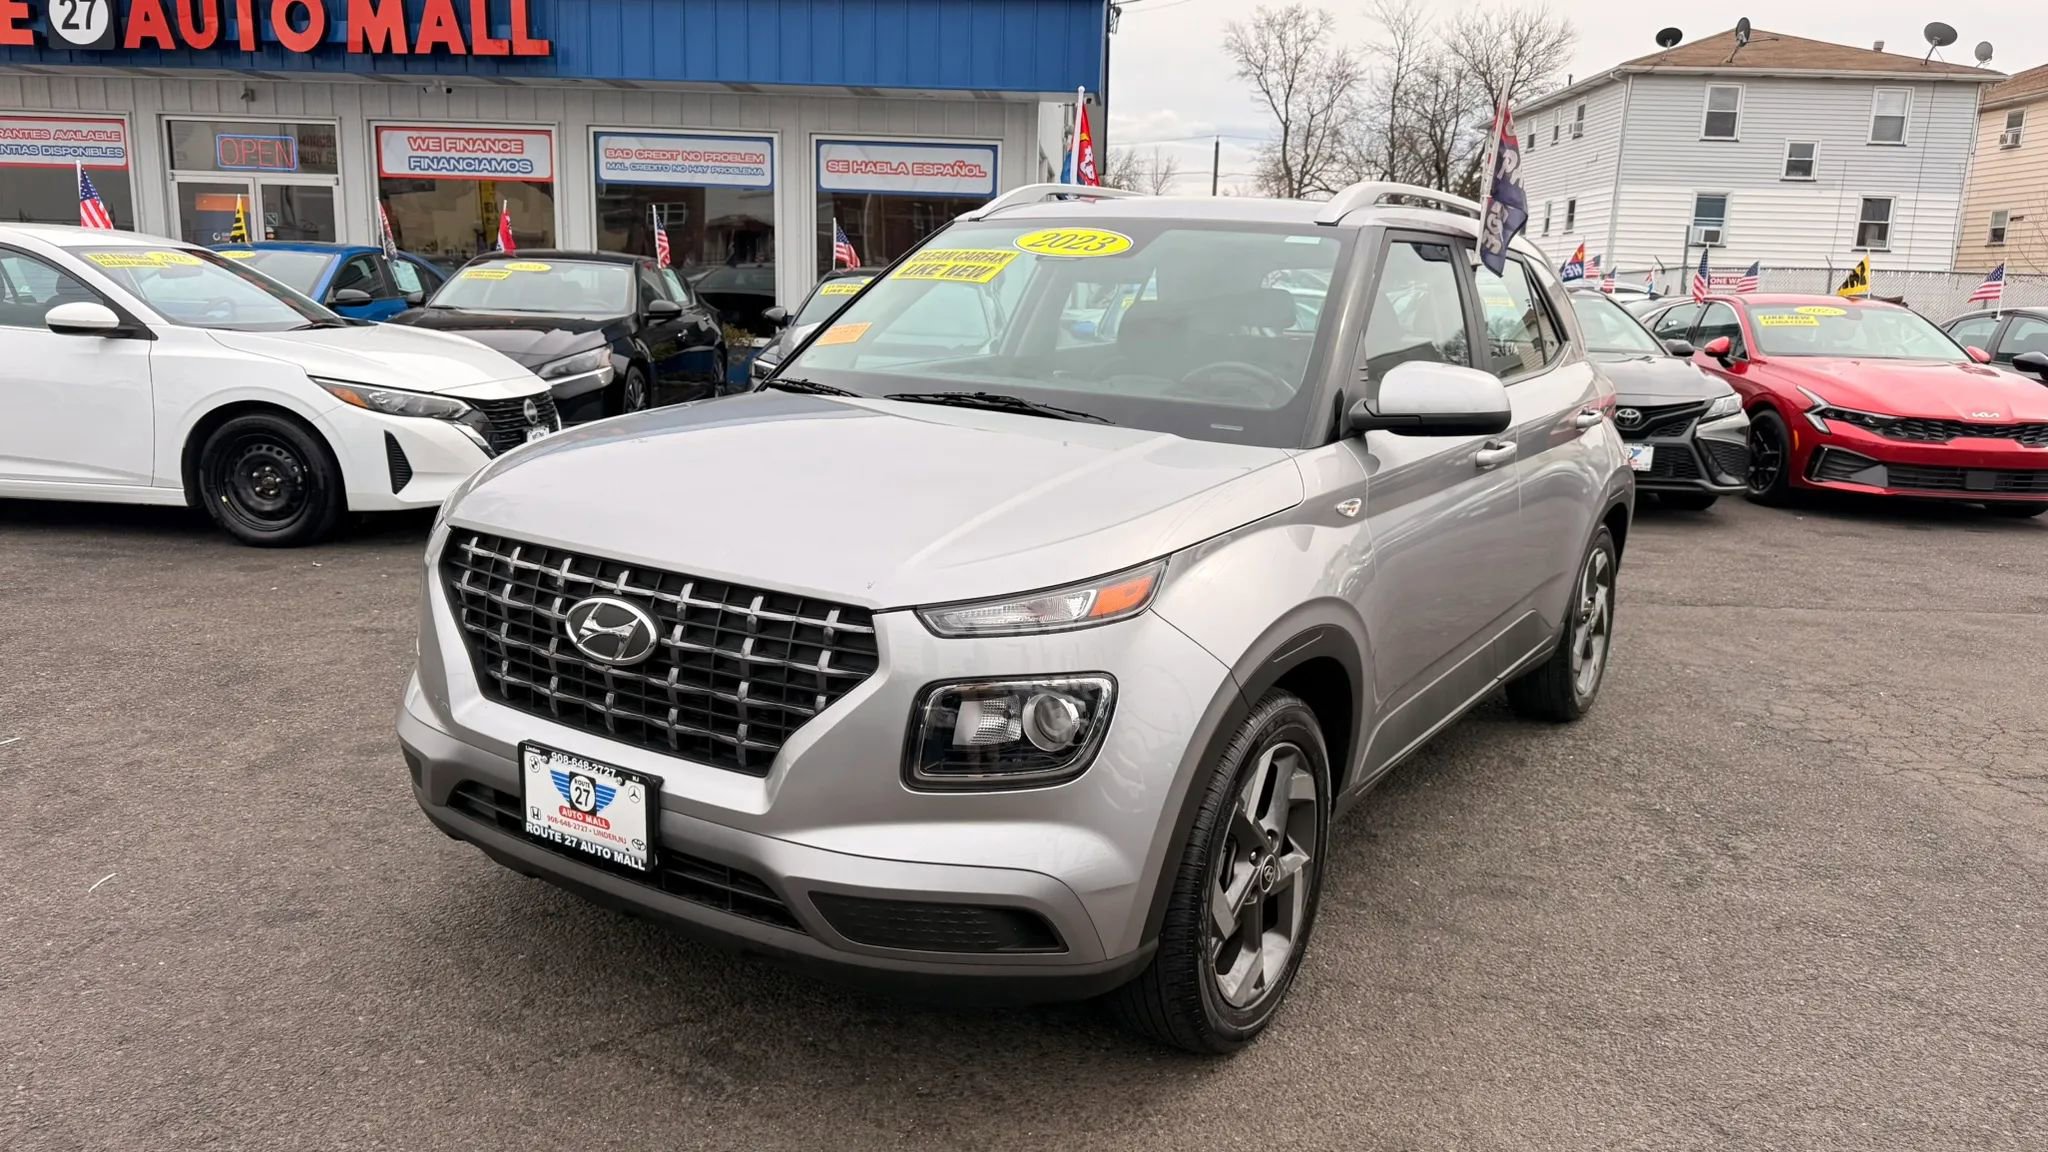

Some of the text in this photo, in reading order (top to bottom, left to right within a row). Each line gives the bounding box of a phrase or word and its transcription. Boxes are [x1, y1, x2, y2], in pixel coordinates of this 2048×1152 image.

[60, 0, 97, 30] 27
[123, 0, 325, 52] AUTO
[347, 0, 550, 56] MALL
[53, 130, 121, 142] AVAILABLE
[41, 145, 125, 158] DISPONIBLES
[221, 138, 294, 168] OPEN
[408, 136, 524, 154] WE FINANCE
[408, 156, 533, 173] FINANCIAMOS
[605, 148, 765, 164] BAD CREDIT NO PROBLEM
[606, 162, 764, 176] MAL CREDITO NO HAY PROBLEMA
[827, 160, 987, 177] SE HABLA ESPAÑOL
[1027, 232, 1118, 252] 2023
[911, 251, 1016, 264] CLEAN CARFAX
[898, 263, 997, 279] LIKE NEW
[1709, 277, 1727, 285] ONE
[551, 752, 616, 778] 908-648-2727
[574, 778, 591, 789] ROUTE
[574, 787, 591, 808] 27
[561, 808, 608, 828] AUTO MALL
[526, 822, 646, 871] ROUTE 27 AUTO MALL
